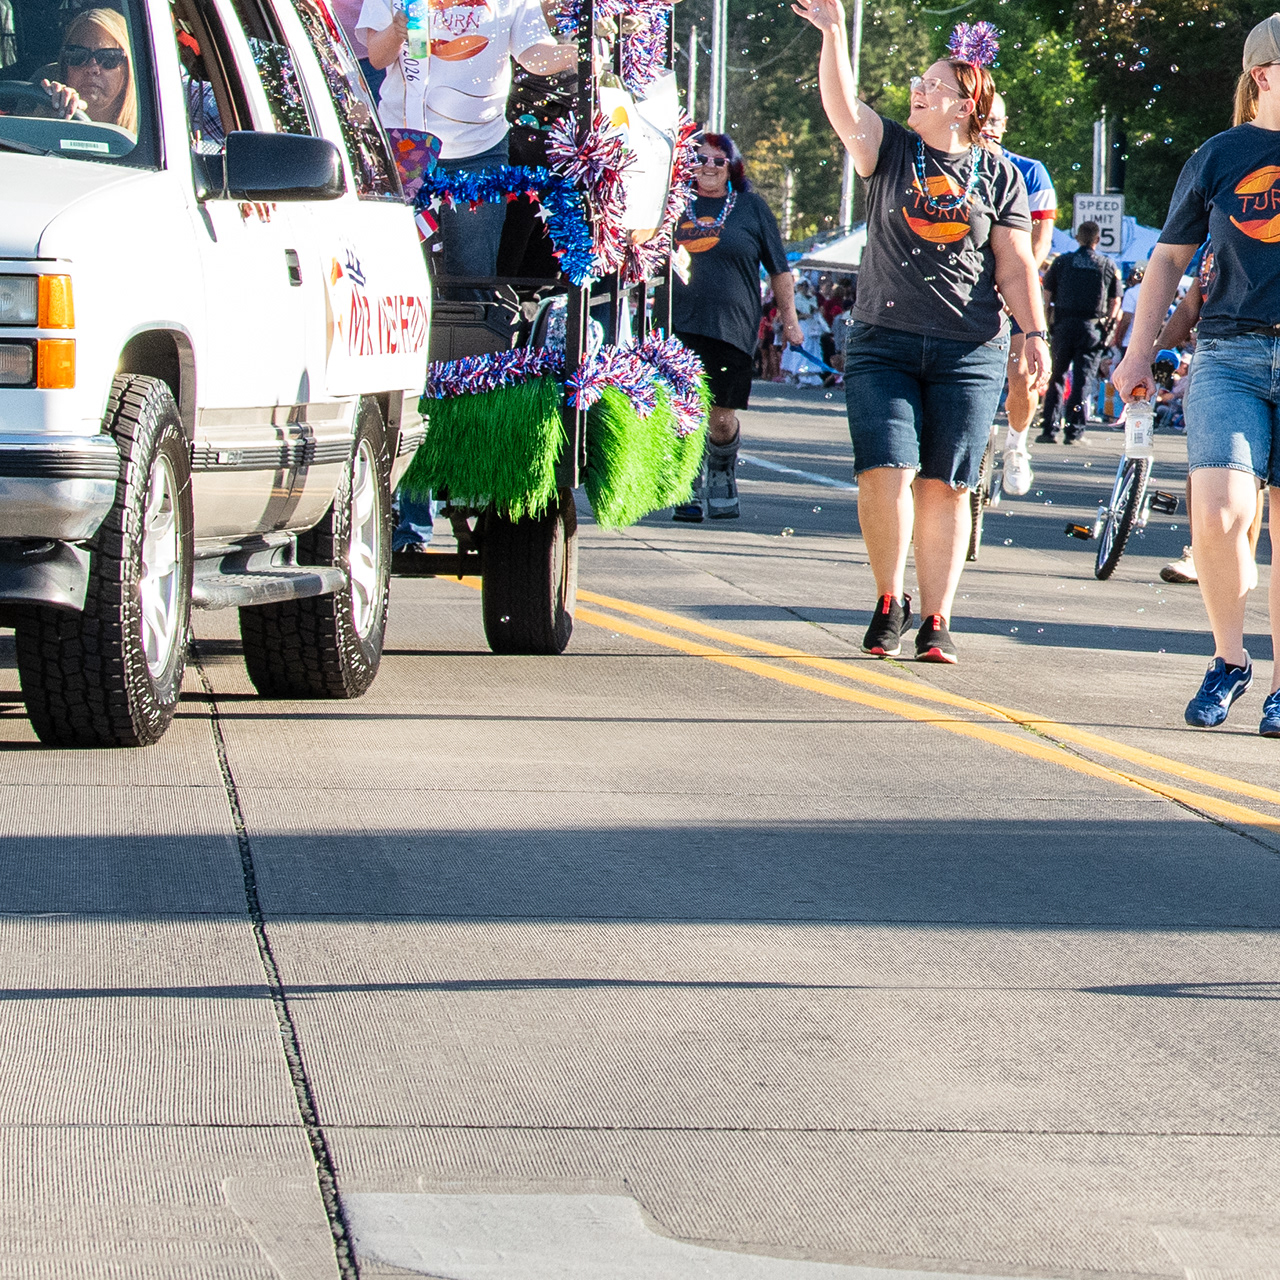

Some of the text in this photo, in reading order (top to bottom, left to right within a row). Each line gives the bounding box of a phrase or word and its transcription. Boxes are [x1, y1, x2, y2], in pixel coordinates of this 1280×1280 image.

[914, 190, 971, 222] TURN
[1079, 200, 1119, 211] SPEED
[1083, 214, 1114, 224] LIMIT
[1100, 228, 1115, 247] 5
